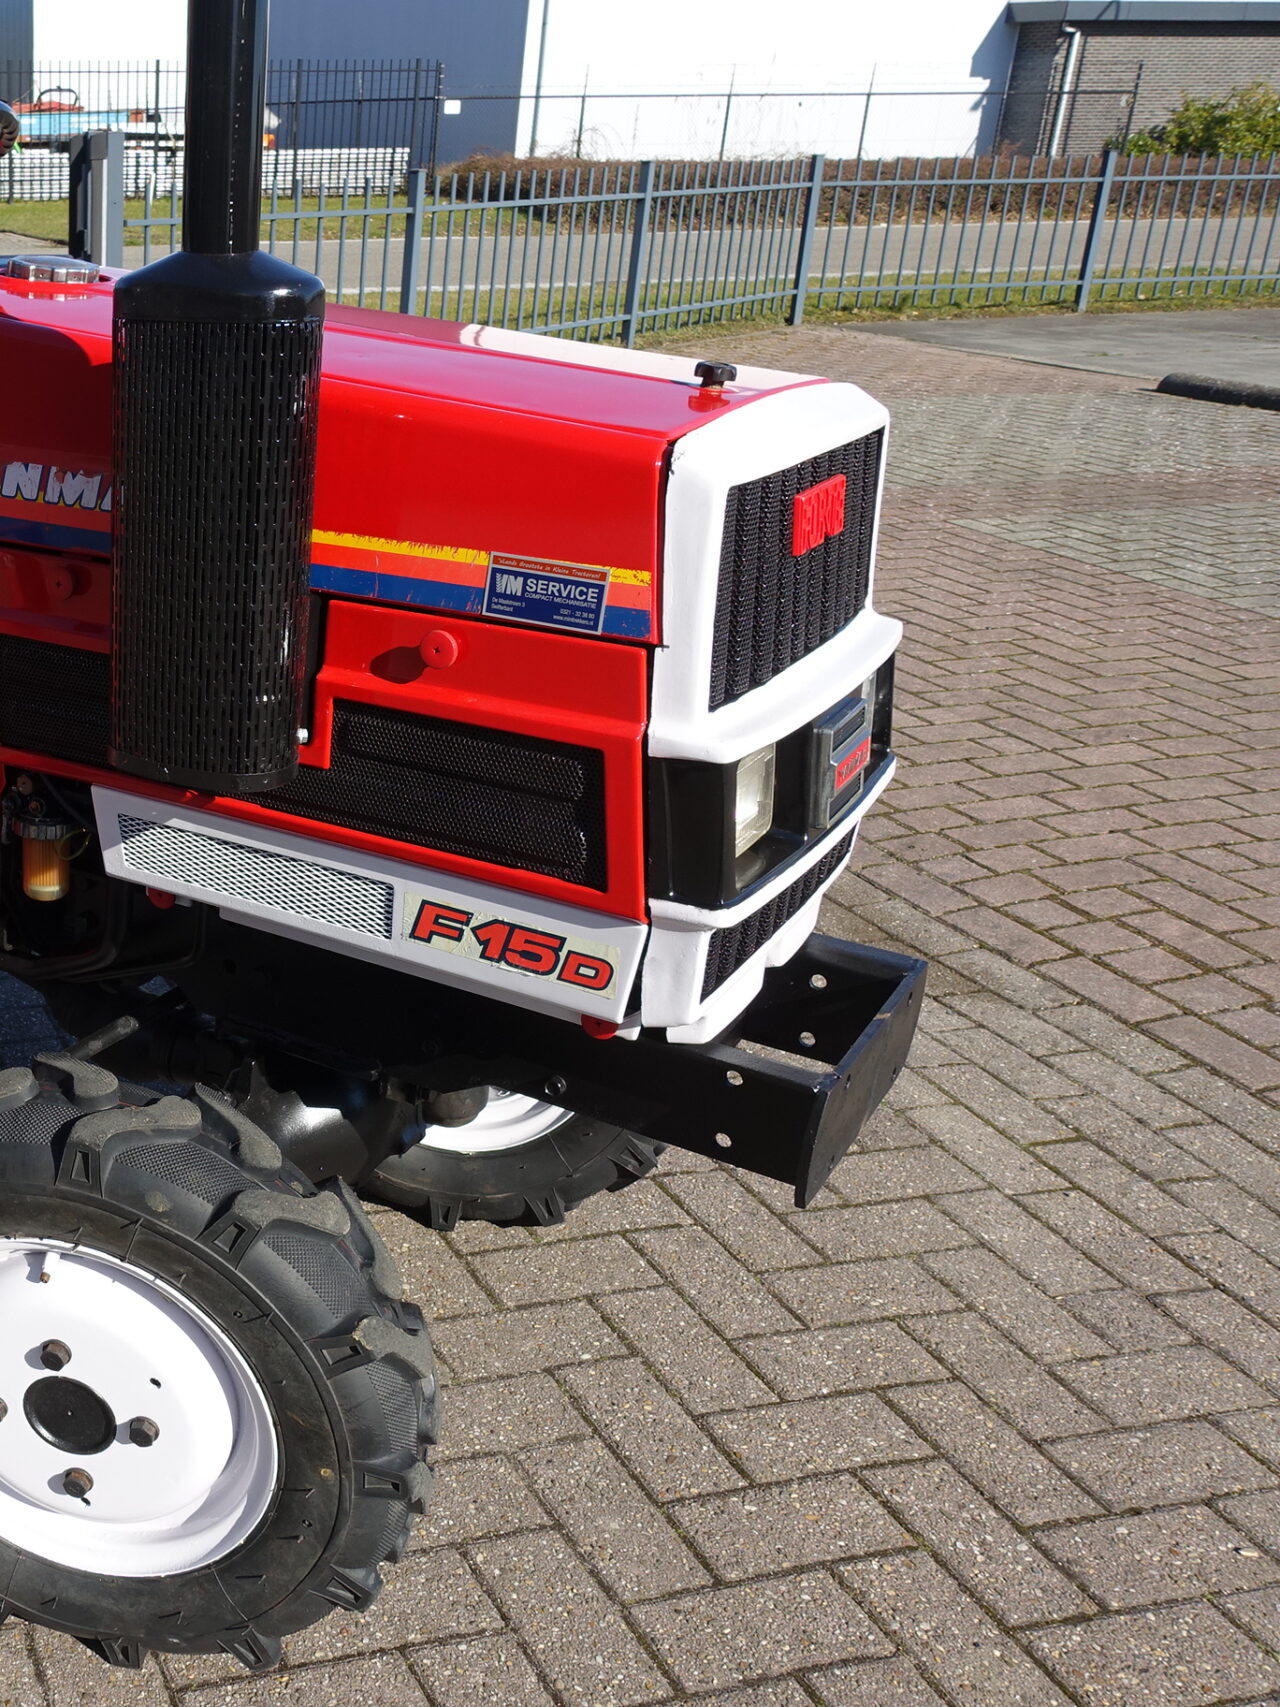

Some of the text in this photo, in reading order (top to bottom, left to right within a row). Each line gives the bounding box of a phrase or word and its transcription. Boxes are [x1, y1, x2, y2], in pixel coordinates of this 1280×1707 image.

[526, 578, 599, 602] SERVICE
[524, 592, 597, 609] COMPACT MECHANISATIE
